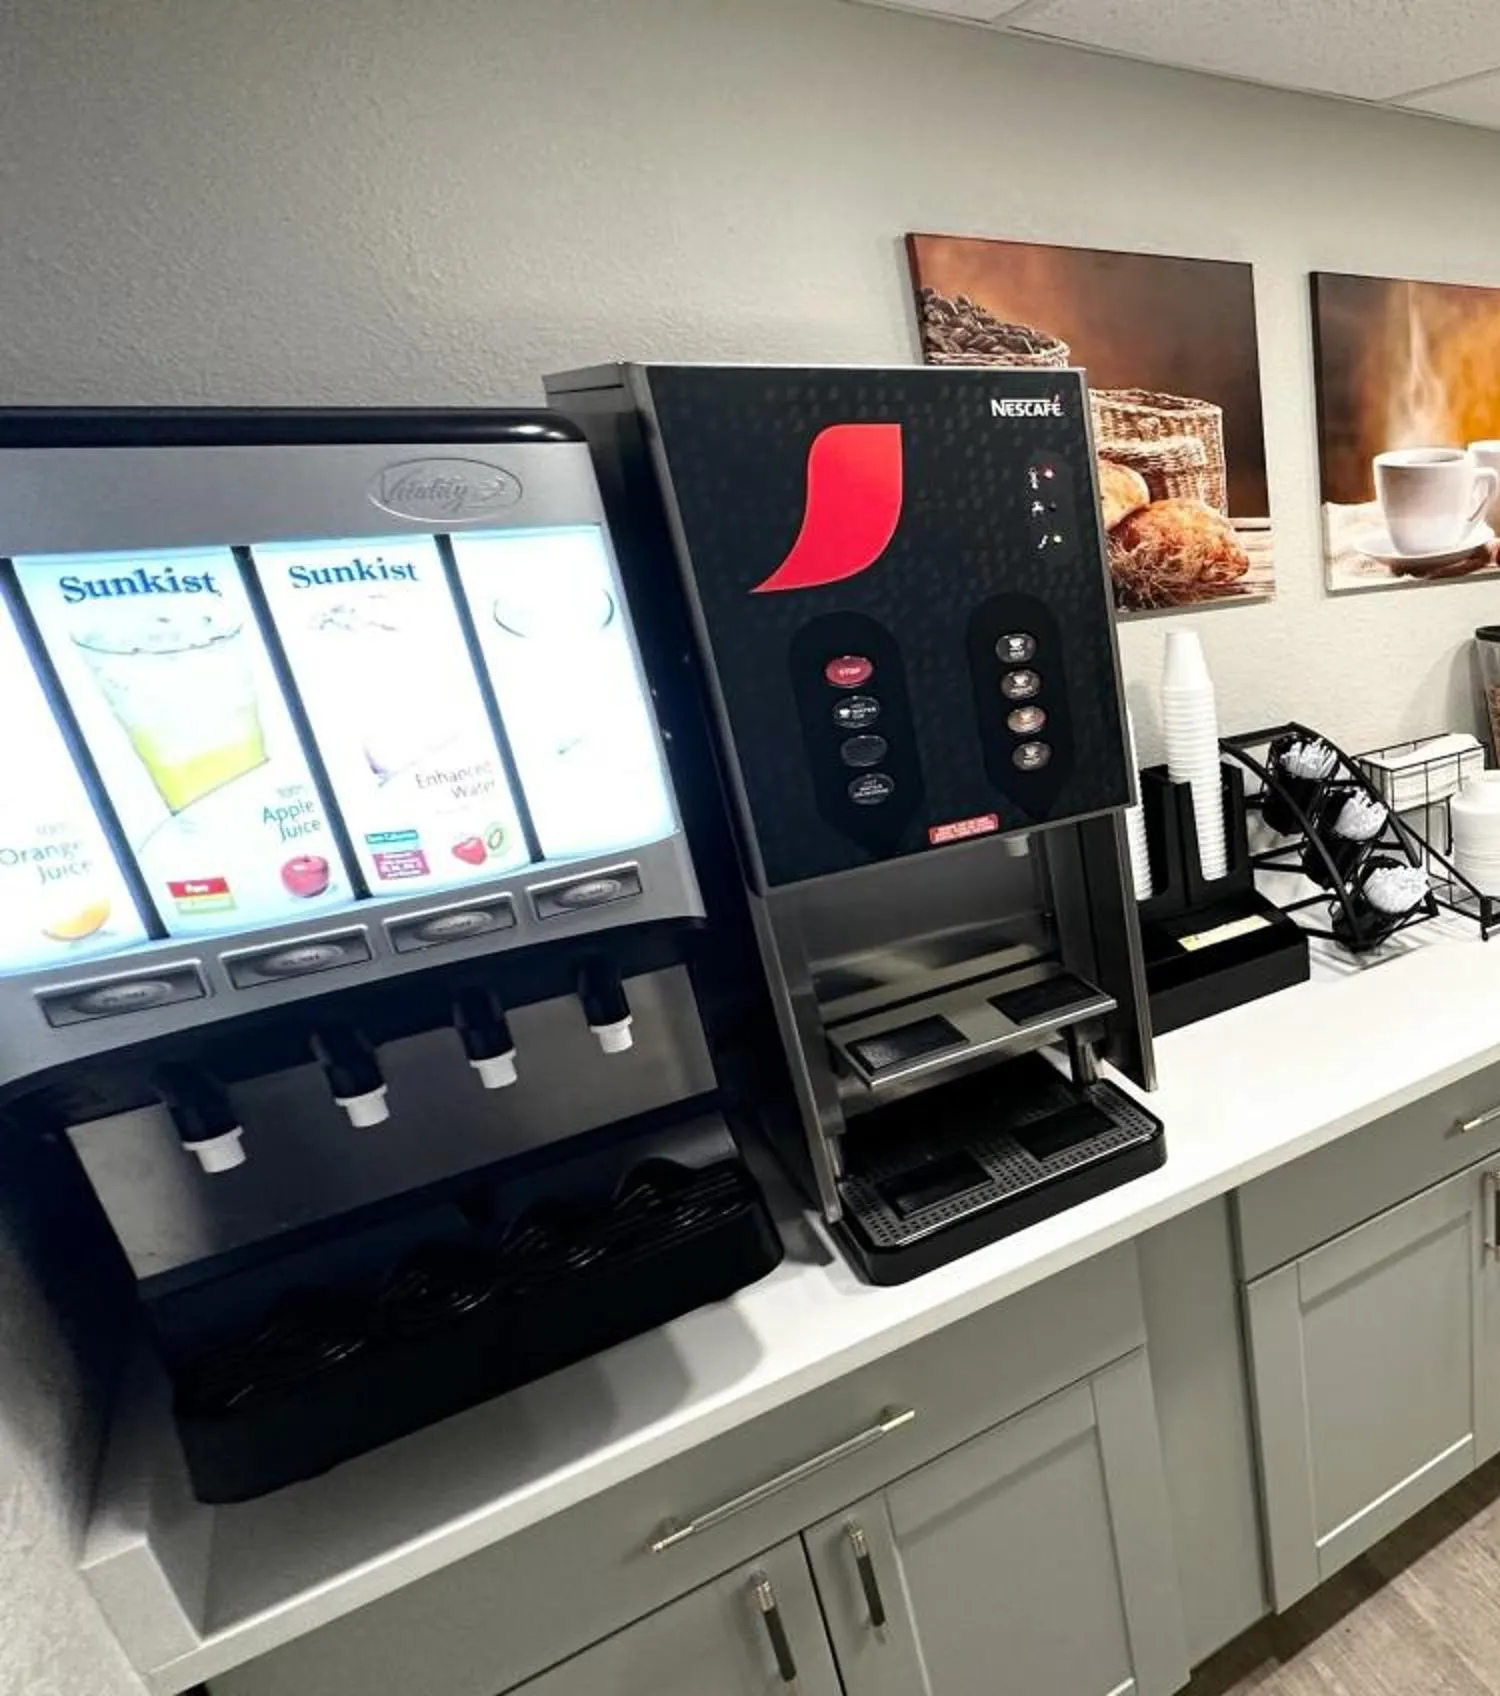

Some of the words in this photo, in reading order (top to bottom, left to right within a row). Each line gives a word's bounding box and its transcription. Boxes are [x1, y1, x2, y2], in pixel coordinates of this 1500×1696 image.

[990, 393, 1064, 417] NESCAFÉ
[59, 567, 222, 603] Sunkist
[288, 557, 420, 589] Sunkist
[263, 799, 315, 825] Apple
[280, 819, 321, 843] Juice
